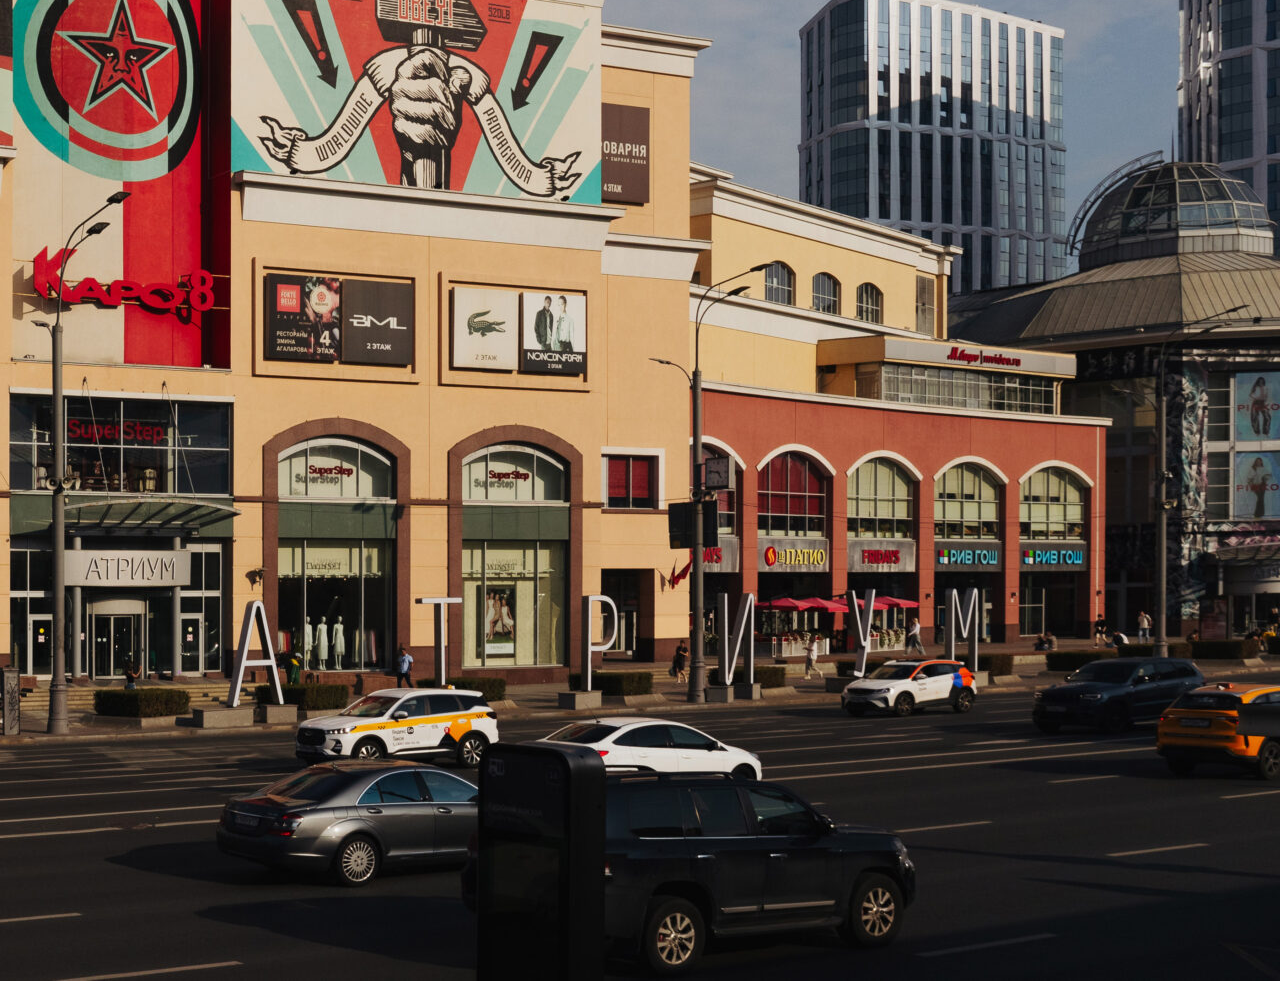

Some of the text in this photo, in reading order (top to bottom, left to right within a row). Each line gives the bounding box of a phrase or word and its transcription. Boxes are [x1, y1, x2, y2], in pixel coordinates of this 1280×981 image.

[315, 93, 373, 162] WORLDWIDE
[483, 107, 532, 184] PROPAGANDA
[601, 140, 647, 158] ОВАРНЯ
[603, 183, 622, 193] 4 ЭТАЖ
[33, 246, 215, 312] КАРО 8
[276, 330, 308, 338] РЕСТОРАНЫ
[319, 330, 331, 346] 4
[316, 347, 335, 355] ЭТАЖ
[371, 343, 392, 351] ЭТАЖ
[527, 351, 583, 363] NONCONFORM
[68, 418, 164, 445] SuperStep
[308, 465, 353, 477] SuperStep
[489, 470, 529, 481] SuperStep
[785, 548, 825, 565] ПАТИО
[862, 549, 901, 565] FRIDAYS
[950, 549, 998, 565] РИВ ГОШ
[1035, 550, 1083, 564] РИВ ГОШ
[85, 556, 176, 581] АТРИУМ
